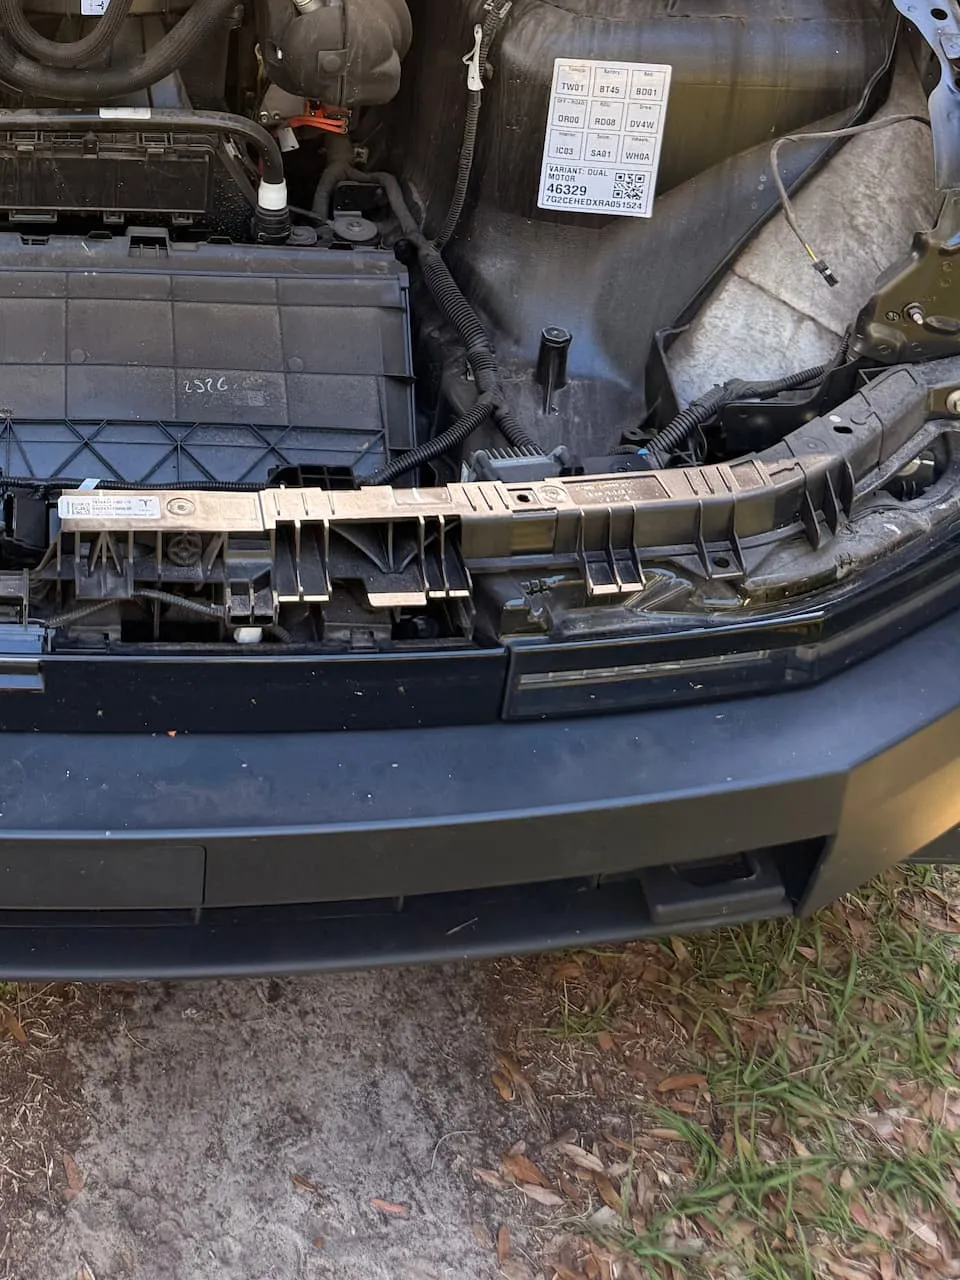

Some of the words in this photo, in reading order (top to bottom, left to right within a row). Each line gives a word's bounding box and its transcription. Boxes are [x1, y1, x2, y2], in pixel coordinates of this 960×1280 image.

[561, 82, 584, 91] TW01
[599, 85, 620, 94] BT45
[635, 88, 657, 96] BD01
[594, 117, 616, 126] RD08
[629, 120, 654, 129] DV4W
[555, 146, 574, 155] IC03
[591, 149, 611, 158] SA01
[548, 165, 585, 175] VARIANT:
[587, 168, 608, 176] DUAL
[547, 173, 576, 182] MOTOR
[546, 183, 587, 196] 46329
